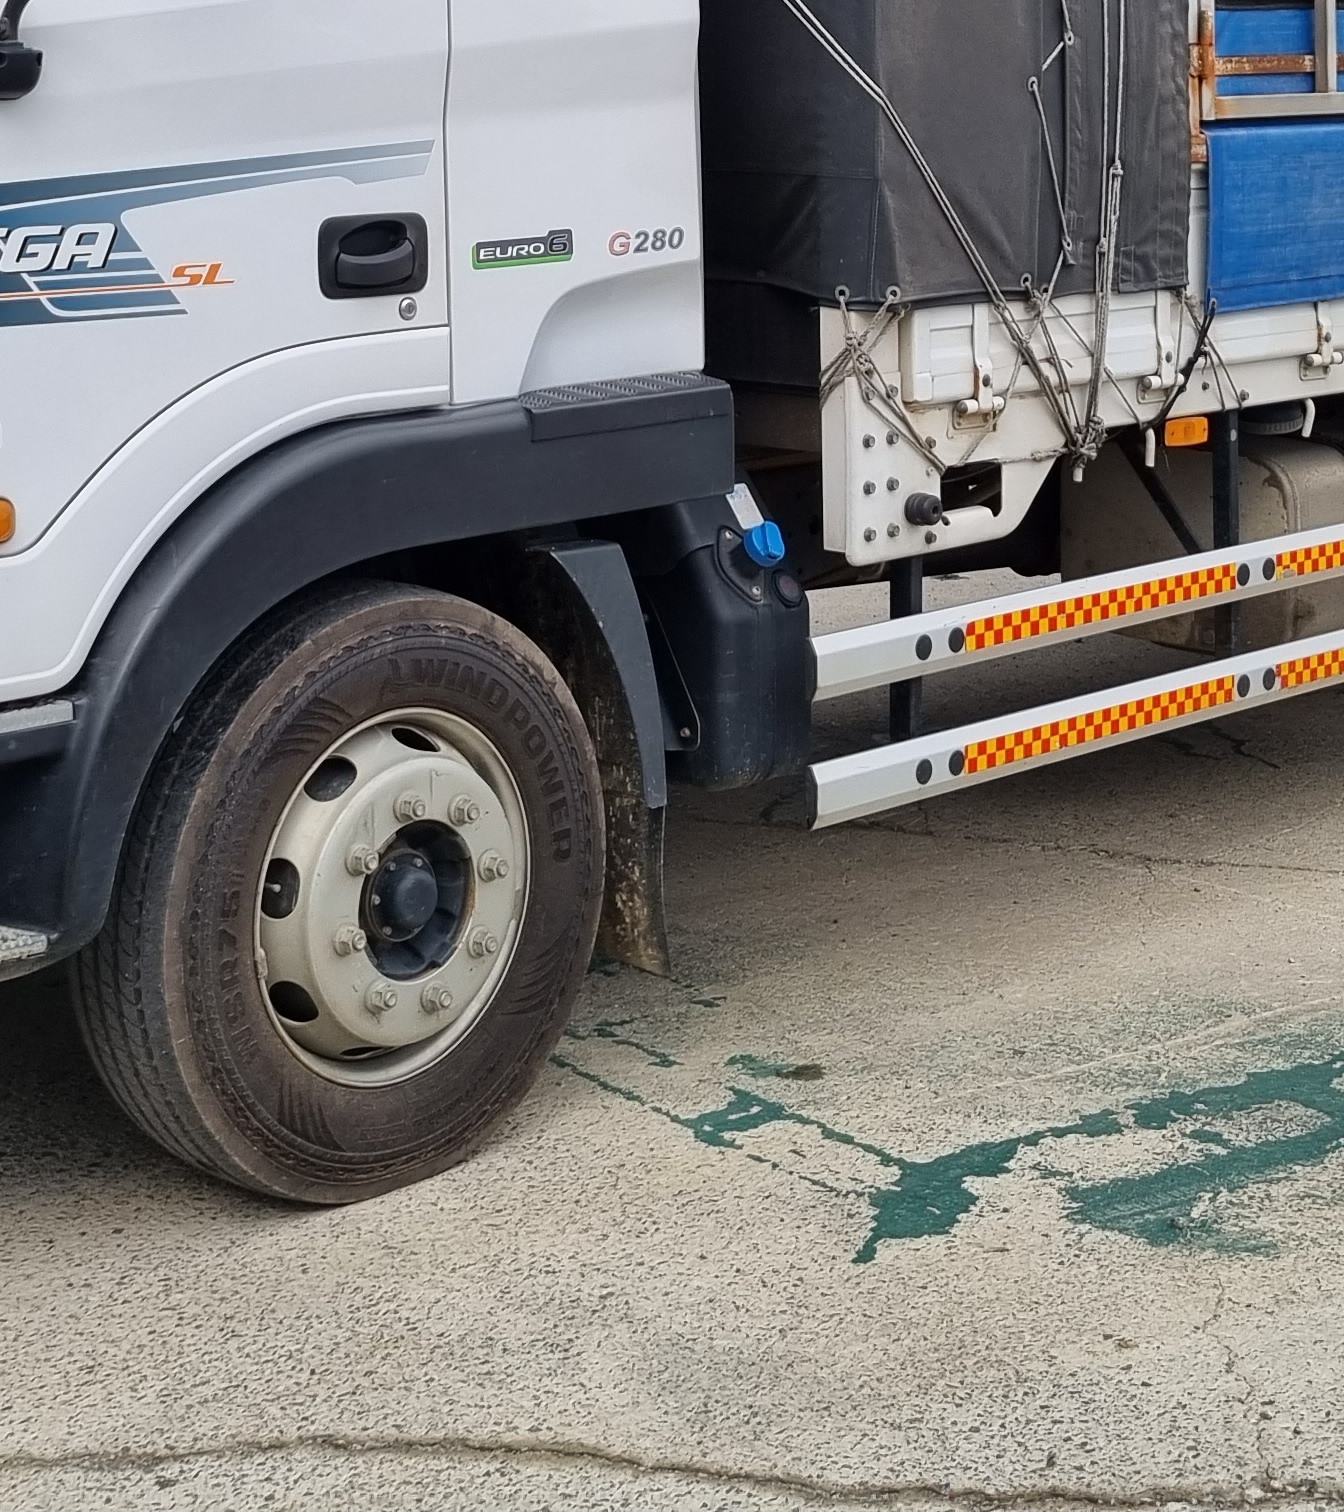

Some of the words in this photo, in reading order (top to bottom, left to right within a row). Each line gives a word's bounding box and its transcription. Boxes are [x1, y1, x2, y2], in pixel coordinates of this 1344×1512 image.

[608, 226, 685, 257] G280
[170, 262, 236, 286] SL
[413, 659, 572, 863] WINDPOWER
